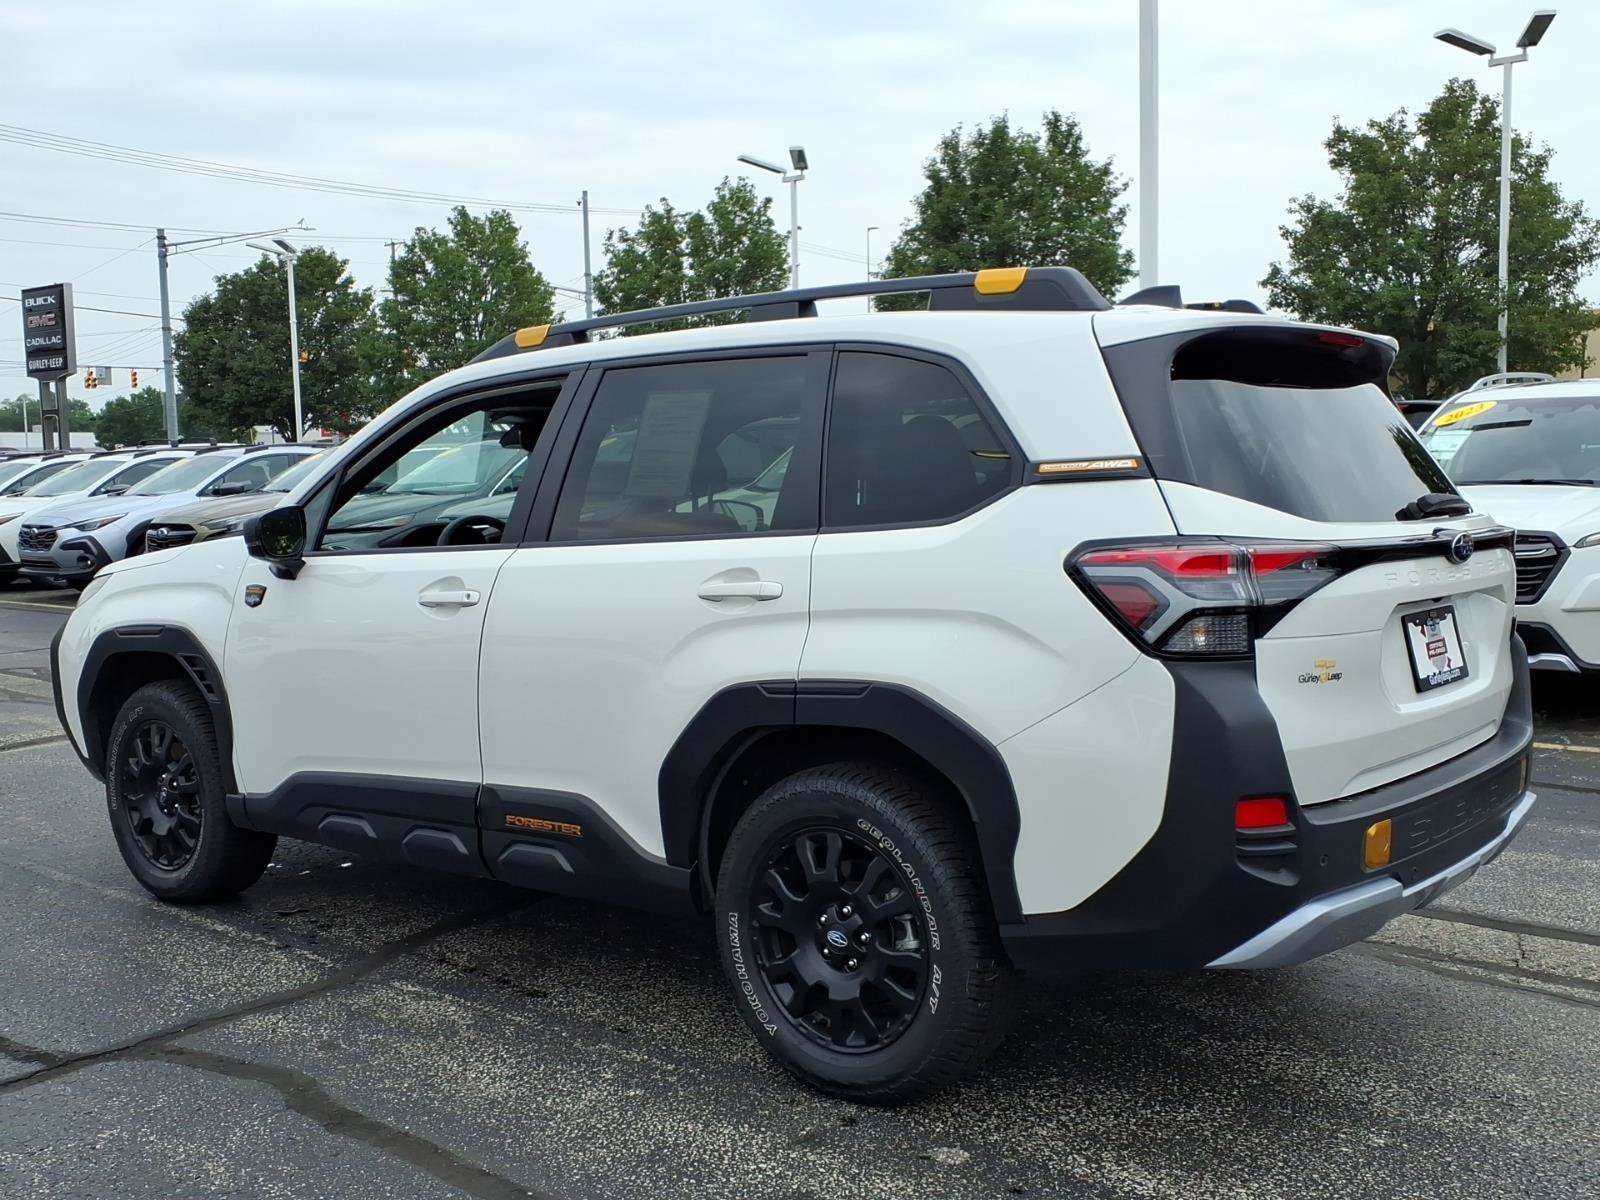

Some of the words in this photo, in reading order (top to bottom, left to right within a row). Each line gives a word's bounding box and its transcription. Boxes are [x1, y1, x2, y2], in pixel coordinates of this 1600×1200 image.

[25, 295, 56, 307] BUICK
[27, 313, 56, 328] GMC
[26, 335, 62, 347] CADILLAC
[505, 814, 582, 836] FORESTER
[856, 818, 941, 951] GEOLANDAR
[928, 963, 943, 1015] A/T
[728, 911, 778, 1037] YOKOHAMA
